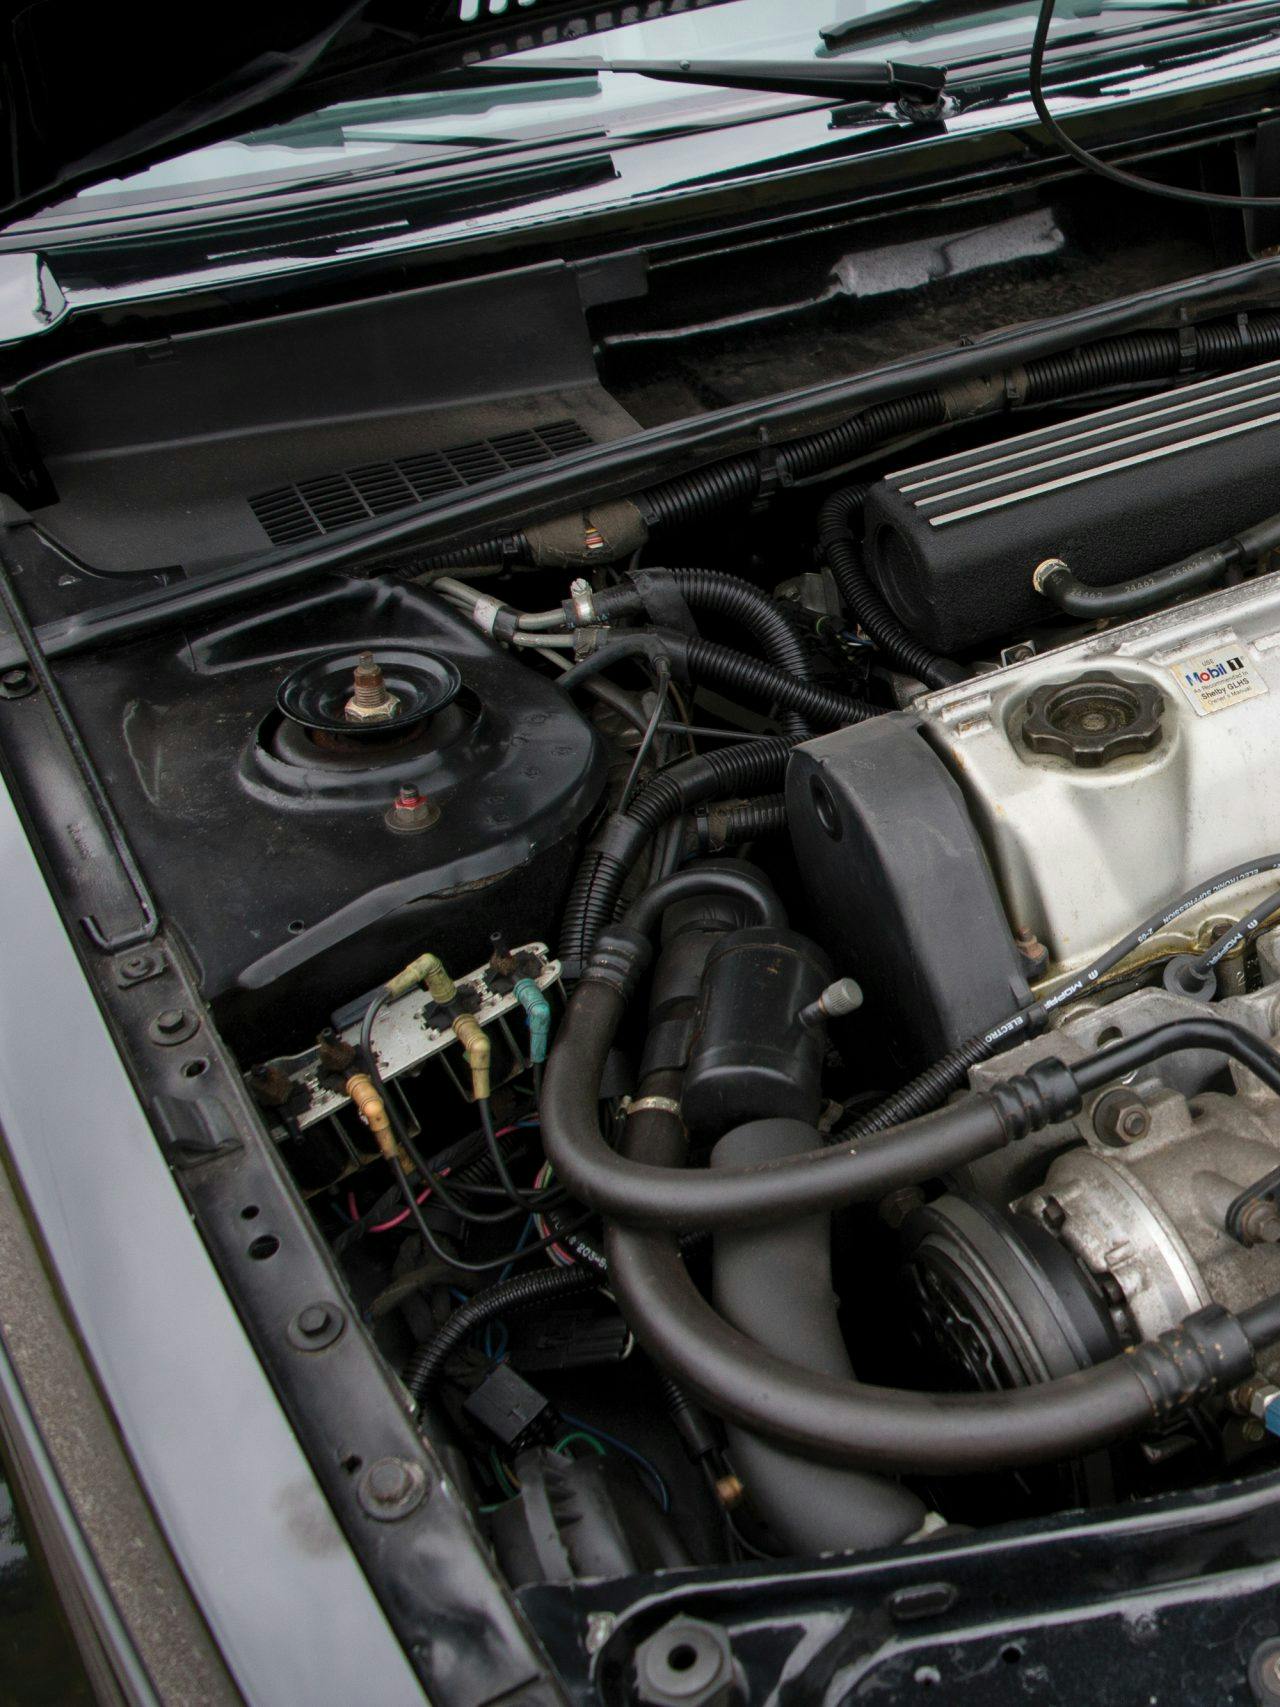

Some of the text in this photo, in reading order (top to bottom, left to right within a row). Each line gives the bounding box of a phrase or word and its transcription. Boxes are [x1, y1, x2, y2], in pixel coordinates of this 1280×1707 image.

[1185, 657, 1243, 687] Mobil 1
[1201, 658, 1215, 667] USE
[1201, 673, 1242, 691] Recommended
[1201, 677, 1250, 700] Shelby GLHS
[1212, 868, 1259, 893] ELECTRONIC
[1162, 889, 1212, 925] SUPPRESSION
[1137, 927, 1154, 944] 2-05
[1208, 932, 1244, 966] MOPAR
[984, 980, 1083, 1043] MOPAR ELECTRO
